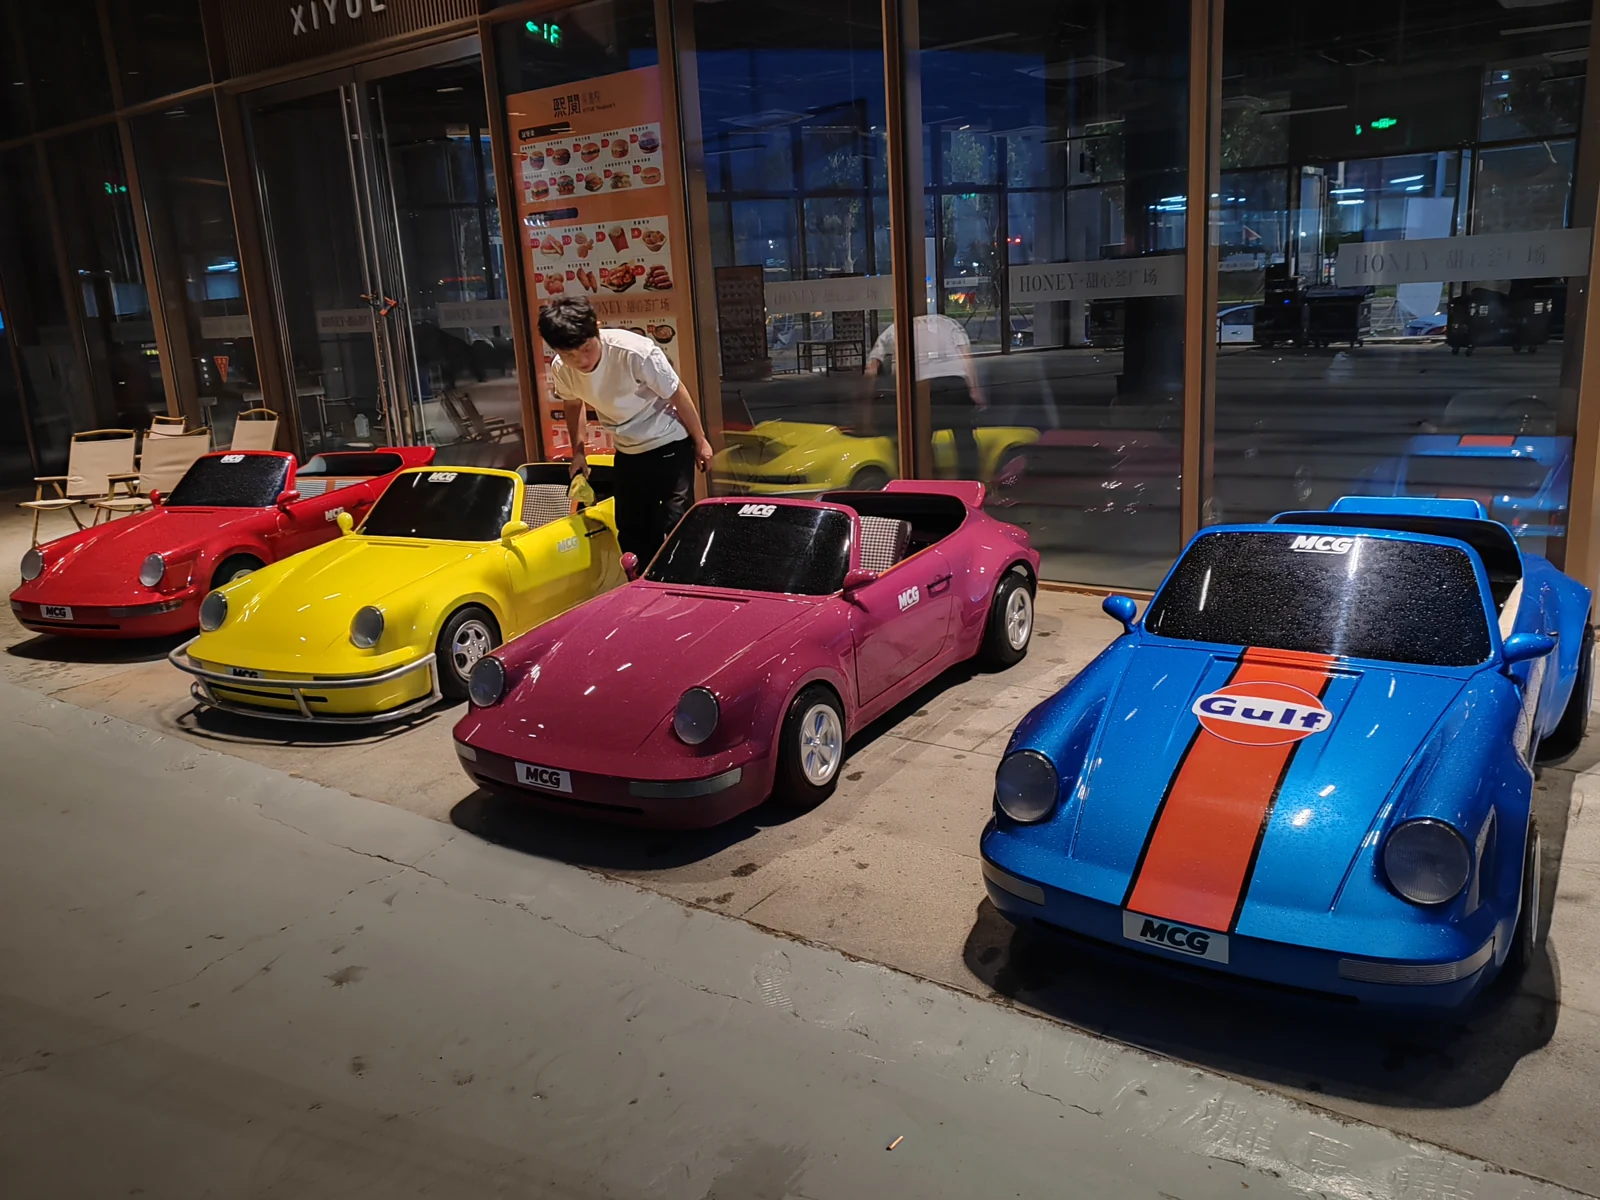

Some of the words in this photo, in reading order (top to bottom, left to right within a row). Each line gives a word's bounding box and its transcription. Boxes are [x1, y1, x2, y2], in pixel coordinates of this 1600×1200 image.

[427, 472, 458, 483] MCG
[737, 504, 777, 518] MCG
[557, 536, 579, 553] MCG
[1289, 535, 1354, 554] MCG
[898, 586, 920, 612] MCG
[45, 606, 67, 618] MCG
[1199, 697, 1326, 729] Gulf
[525, 766, 561, 788] MCG
[1140, 919, 1210, 955] MCG
